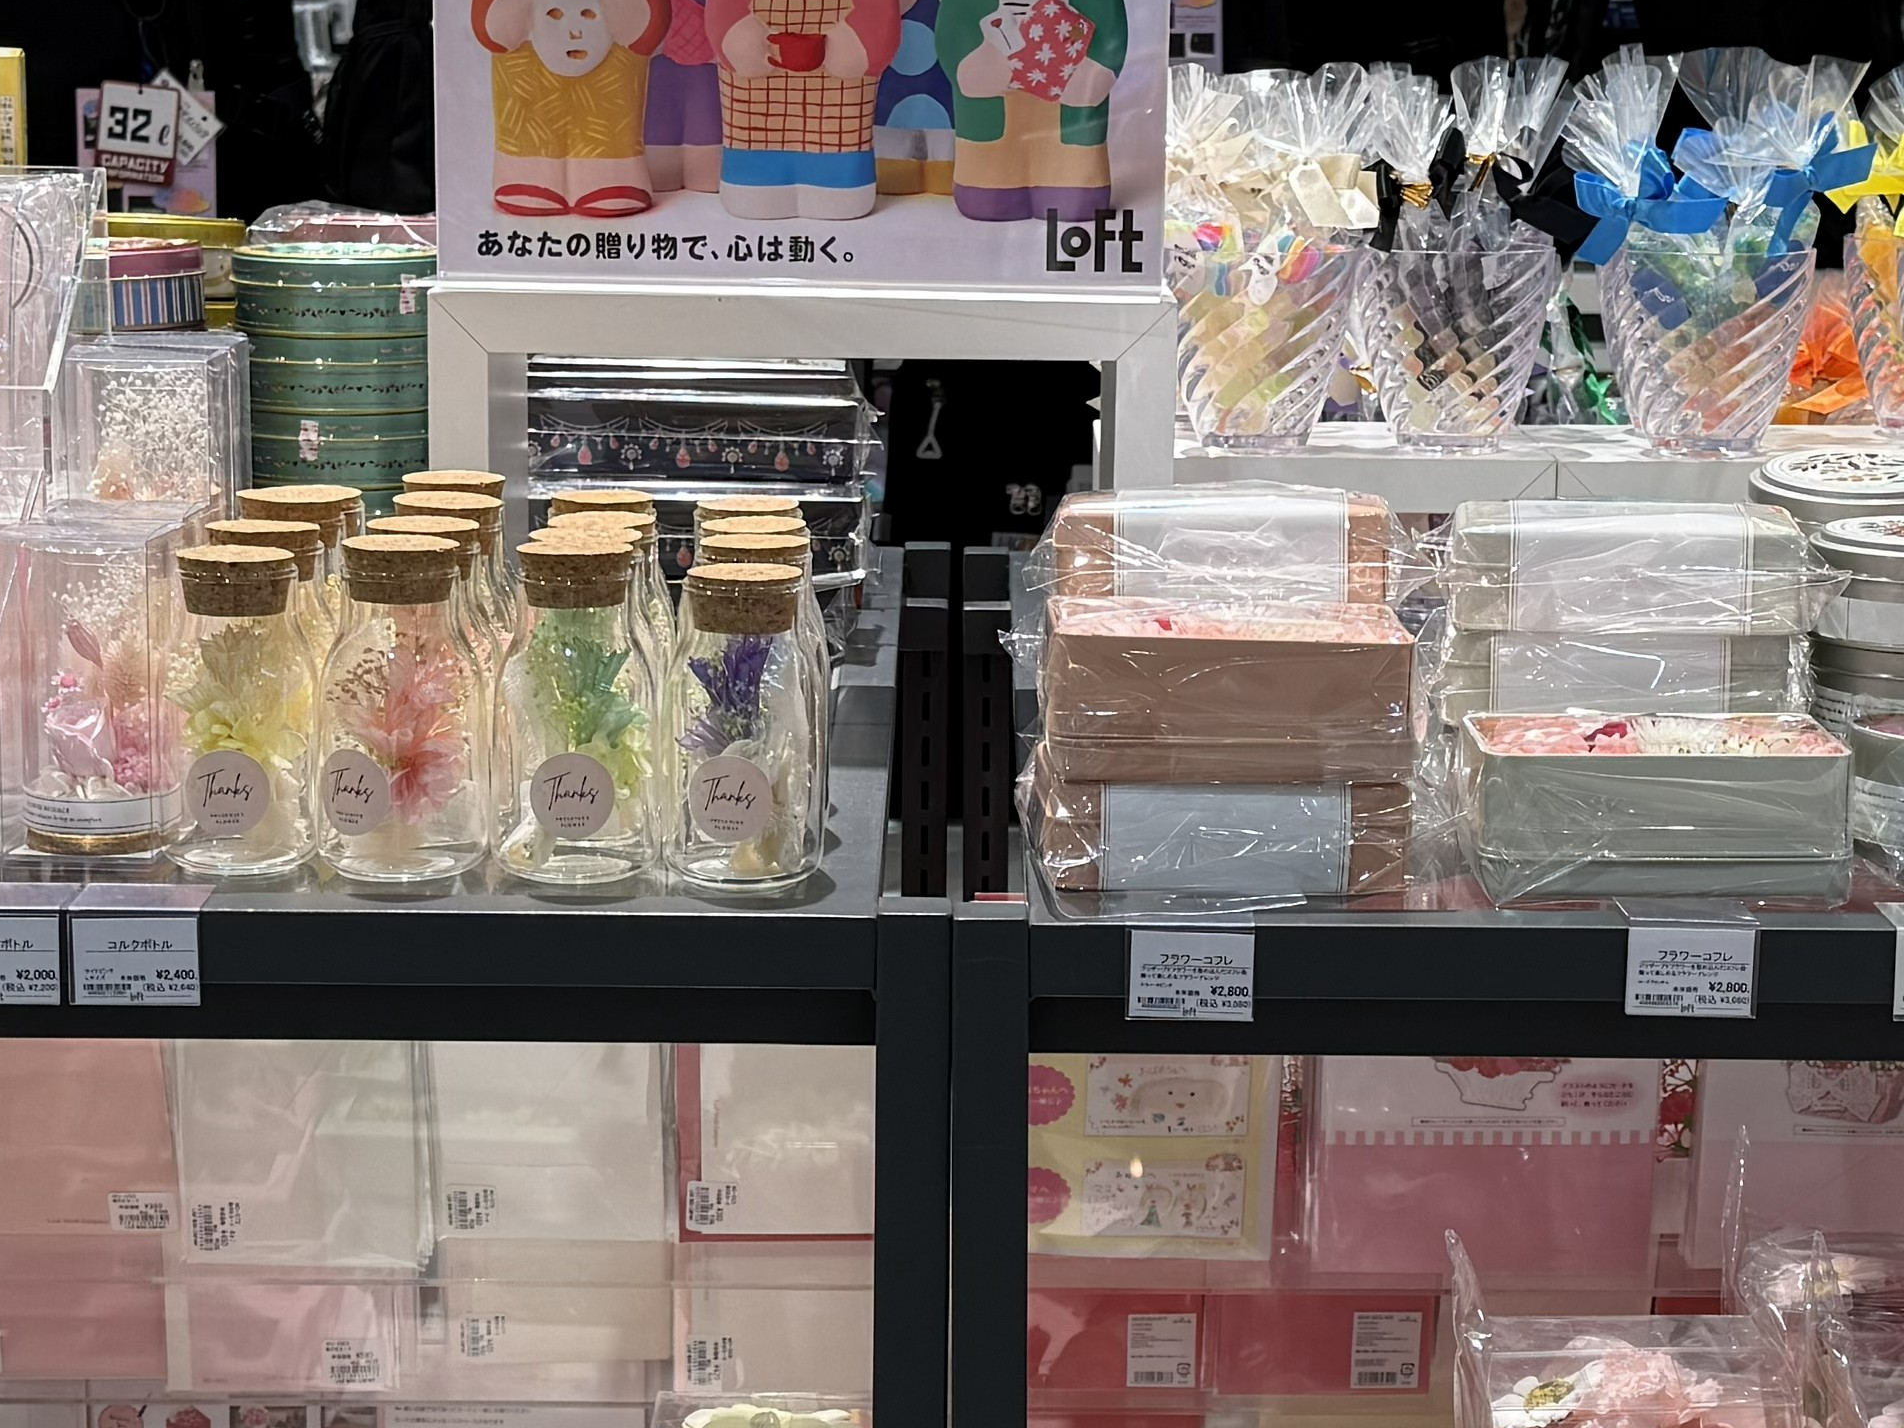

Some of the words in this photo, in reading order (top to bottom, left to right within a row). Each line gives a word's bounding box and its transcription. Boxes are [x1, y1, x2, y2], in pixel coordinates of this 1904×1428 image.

[107, 95, 152, 144] 32
[101, 153, 170, 174] CAPACITY
[477, 230, 855, 267] あなたの贈り物で、心は動く。
[1045, 207, 1145, 275] Loft
[197, 768, 254, 808] Thanks
[330, 767, 374, 804] Thanks
[543, 771, 599, 812] Thanks
[702, 774, 756, 812] Thanks
[108, 939, 173, 952] コルクボトル
[1159, 953, 1234, 967] フラワーコフレ
[1658, 950, 1734, 962] フラワーコフレ
